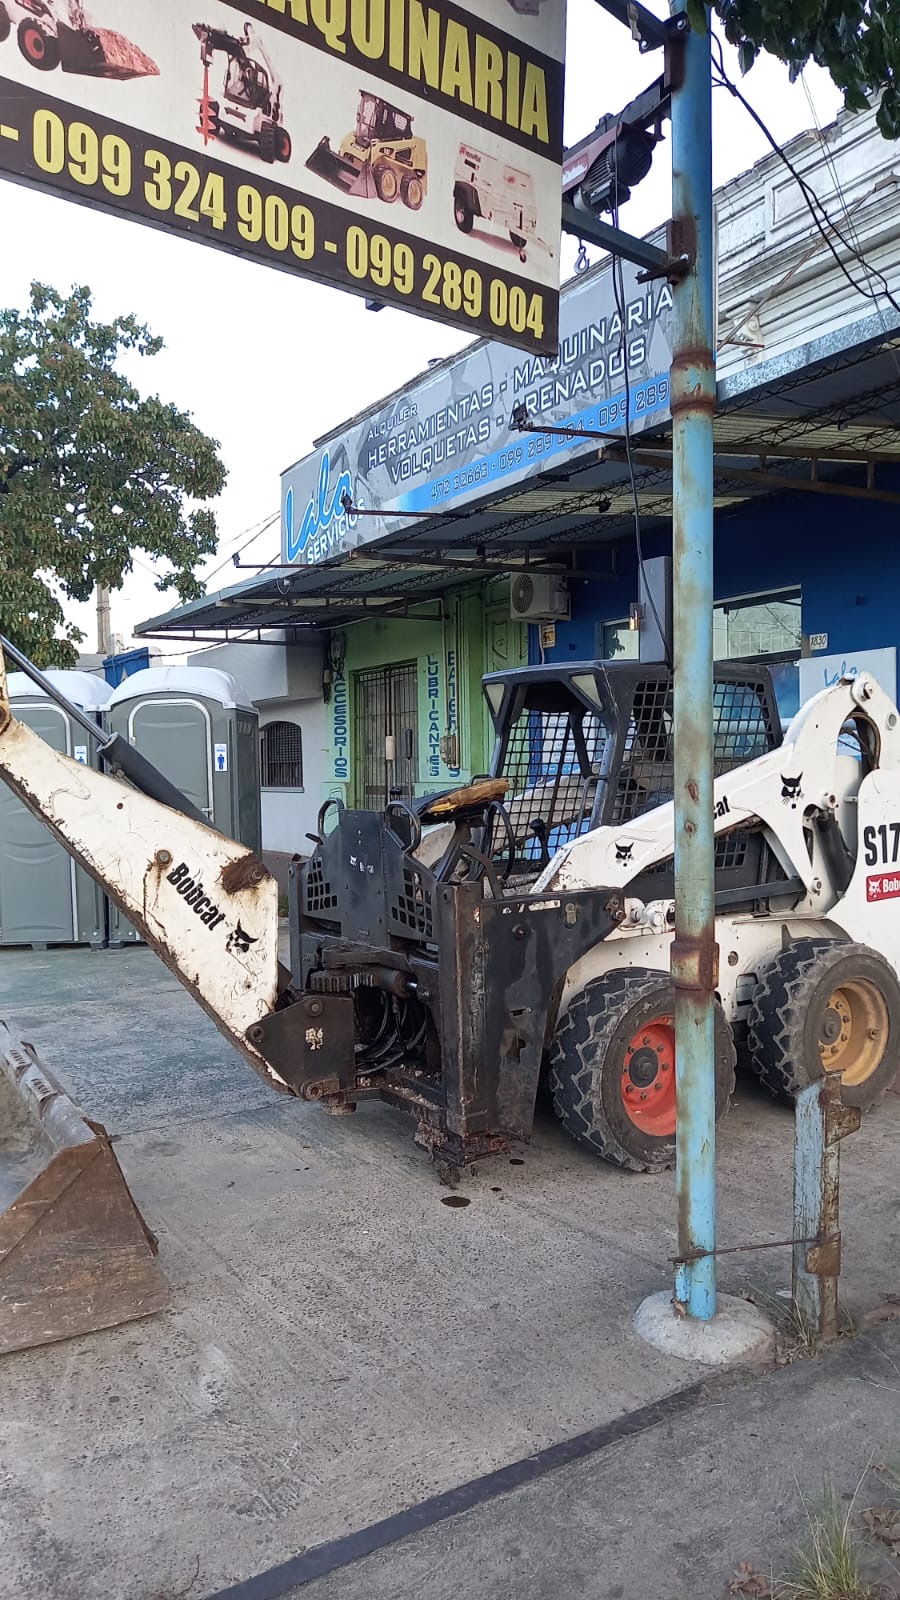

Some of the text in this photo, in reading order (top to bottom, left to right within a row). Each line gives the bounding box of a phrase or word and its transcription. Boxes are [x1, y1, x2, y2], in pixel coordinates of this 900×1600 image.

[252, 0, 550, 144] QUINARIA
[32, 109, 132, 197] 099
[143, 148, 228, 231] 324
[236, 184, 316, 260] 909
[345, 225, 416, 294] 099
[421, 253, 483, 319] 289
[489, 278, 545, 339] 004
[367, 404, 418, 442] ALQUILER
[367, 382, 494, 470] HERRAMIENTAS
[390, 415, 491, 485] VOLQUETAS
[499, 444, 523, 472] 099
[598, 398, 629, 428] 099
[635, 378, 671, 414] 289
[333, 671, 348, 778] ACCESORIOS
[427, 655, 440, 777] LUBRICANTES
[447, 651, 461, 777] BATERS
[166, 862, 225, 931] Bobcat
